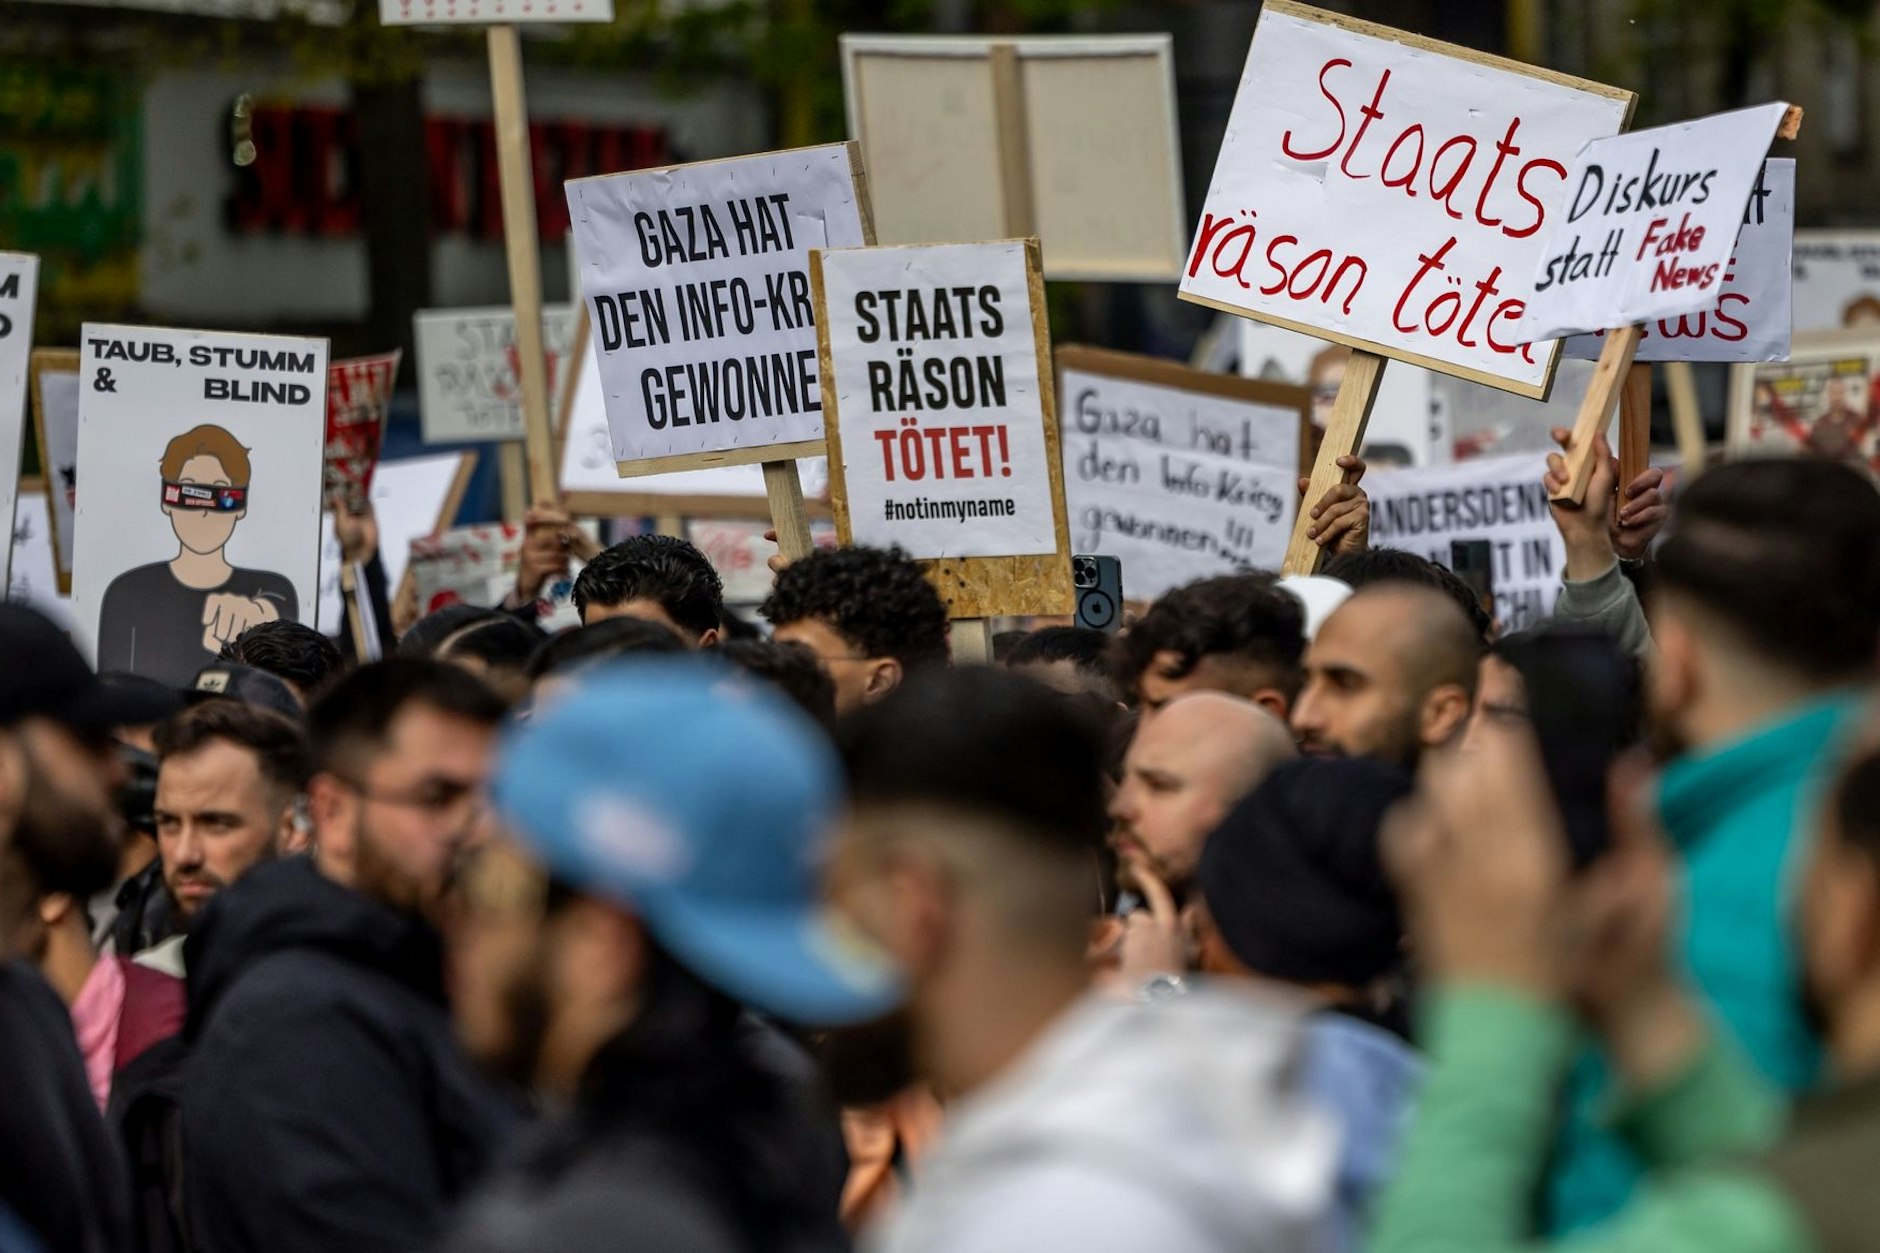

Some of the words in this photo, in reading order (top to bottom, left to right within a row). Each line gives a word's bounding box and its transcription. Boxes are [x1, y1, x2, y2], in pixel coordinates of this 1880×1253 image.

[1282, 58, 1568, 238] Staats
[1567, 147, 1718, 224] Diskurs
[634, 203, 730, 268] GAZA
[726, 193, 795, 256] HAT
[1188, 209, 1368, 316] räson
[1534, 228, 1625, 292] statt
[1635, 212, 1706, 262] Fake
[1650, 256, 1720, 293] News
[593, 288, 671, 351] DEN
[854, 285, 1005, 344] STAATS
[88, 338, 182, 368] TAUB,
[189, 345, 315, 374] STUMM
[93, 366, 117, 393] &
[203, 378, 311, 406] BLIND
[867, 347, 1007, 412] RÄSON
[874, 416, 1012, 482] TÖTET!
[1075, 387, 1162, 443] Gaza
[1190, 410, 1259, 461] hat
[1077, 438, 1141, 485] den
[884, 497, 1016, 523] #notinmyname
